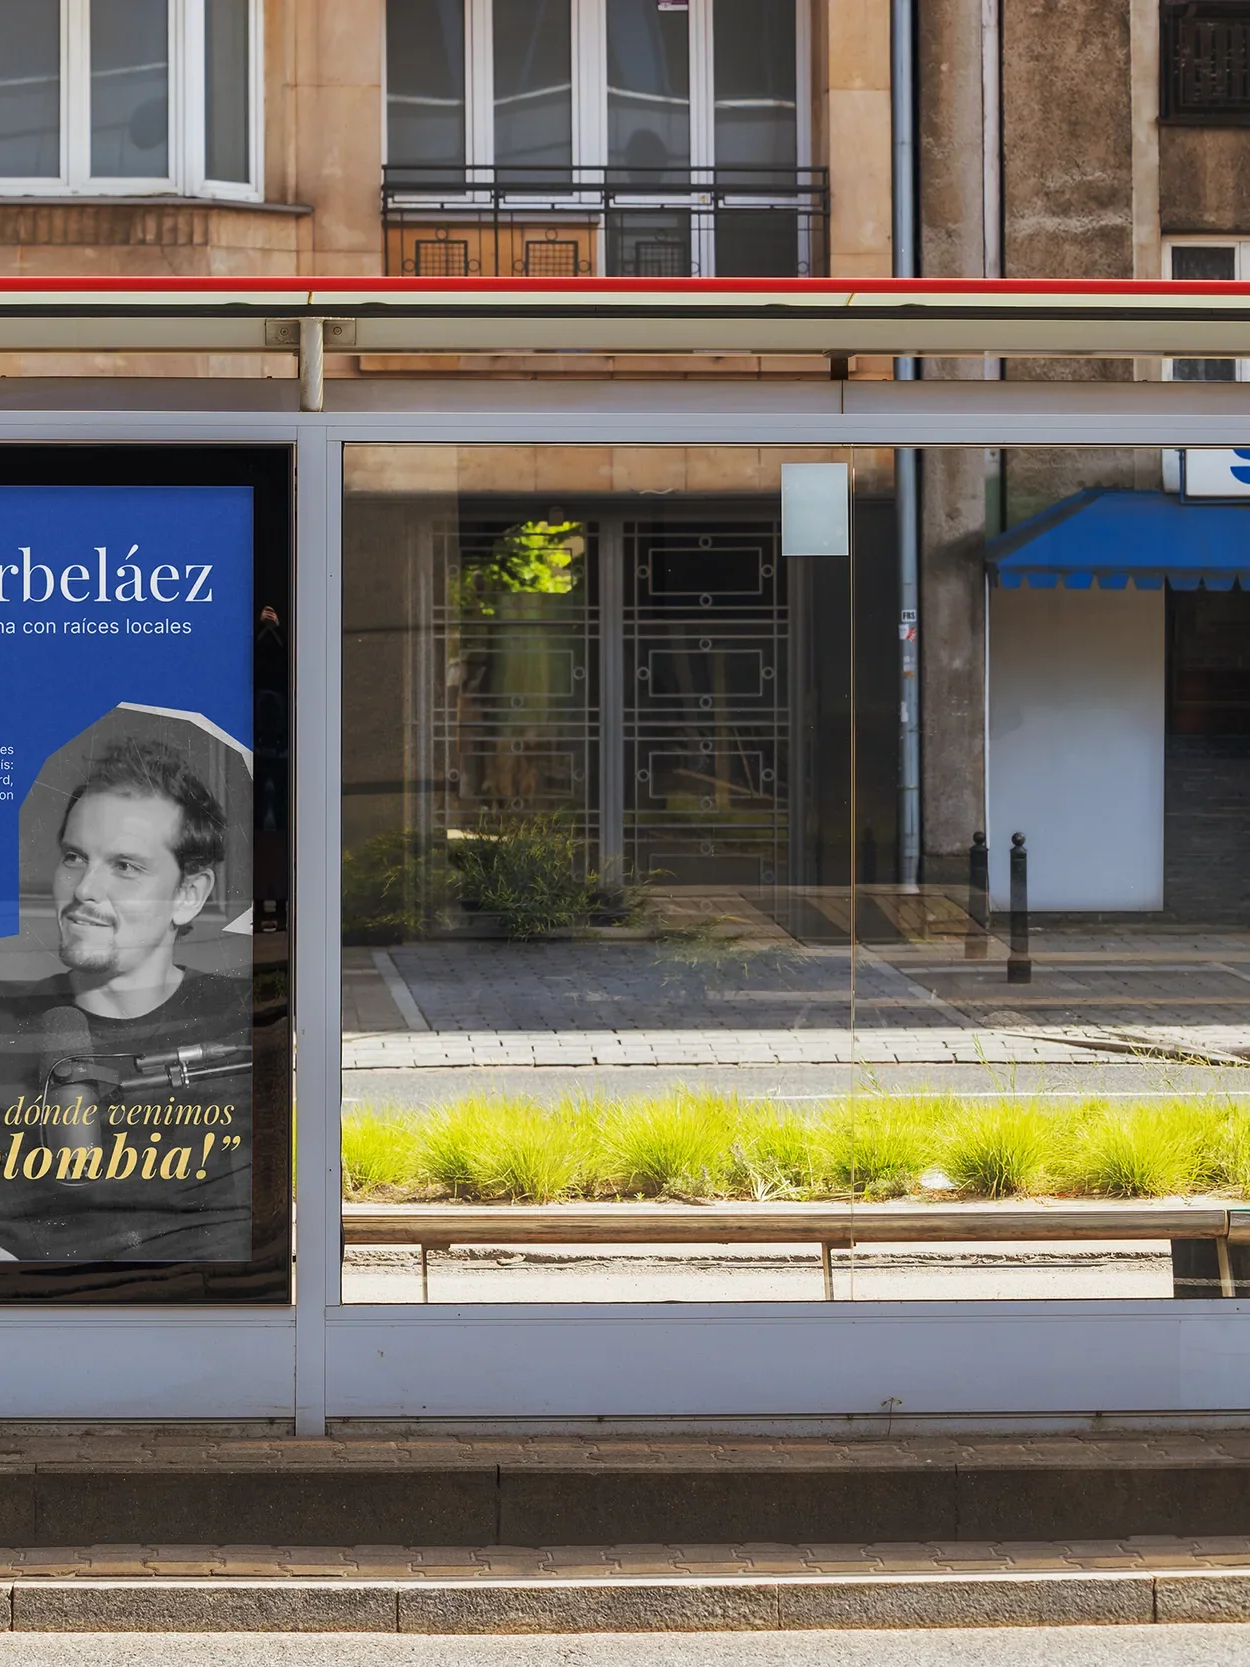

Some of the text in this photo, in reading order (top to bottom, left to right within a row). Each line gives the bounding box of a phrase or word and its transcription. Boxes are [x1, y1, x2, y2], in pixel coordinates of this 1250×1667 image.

[22, 621, 56, 634] con
[64, 618, 119, 633] raíces
[127, 619, 191, 633] locales
[4, 1094, 98, 1126] dónde
[107, 1096, 235, 1126] venimos
